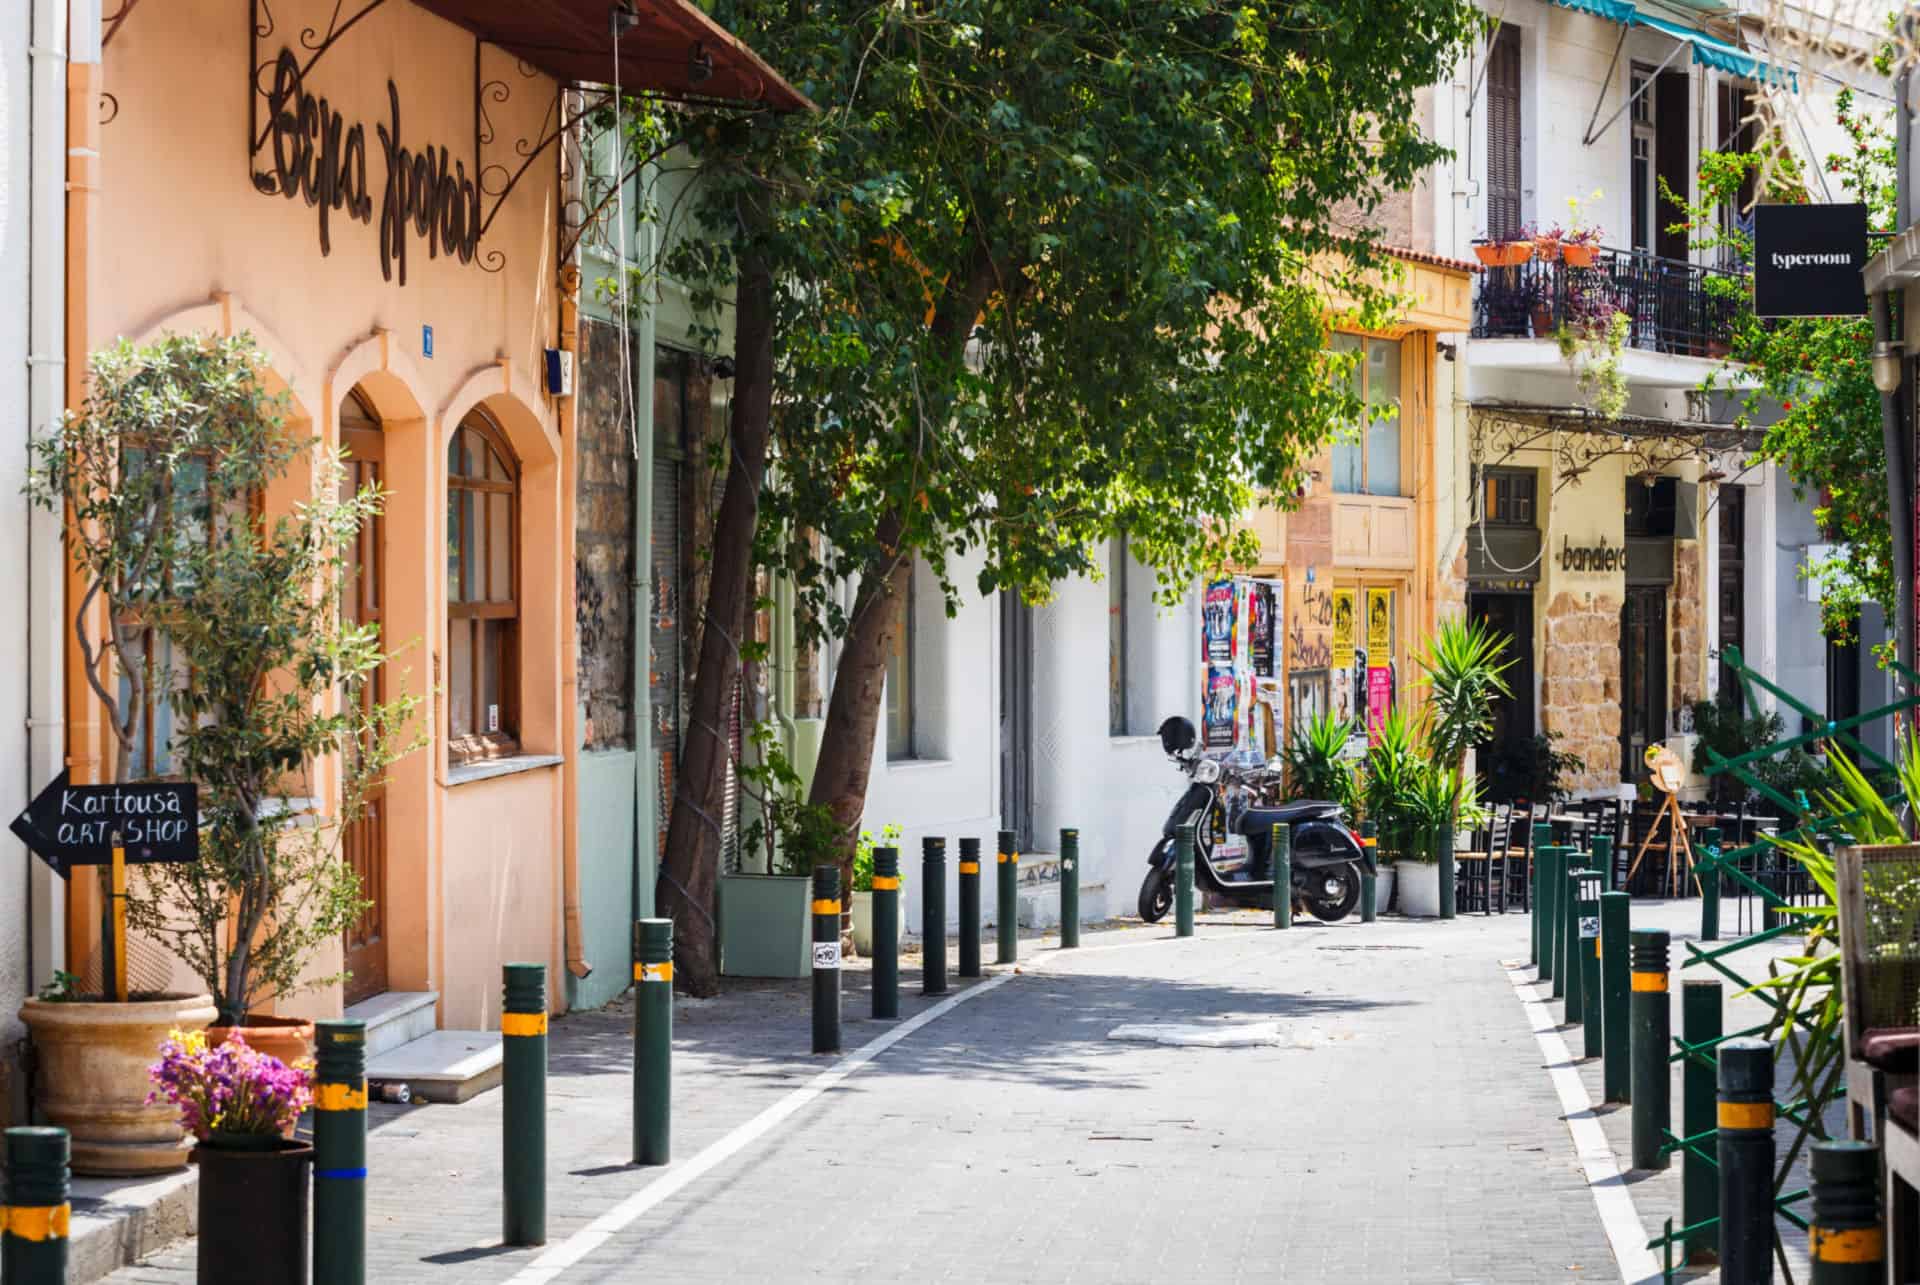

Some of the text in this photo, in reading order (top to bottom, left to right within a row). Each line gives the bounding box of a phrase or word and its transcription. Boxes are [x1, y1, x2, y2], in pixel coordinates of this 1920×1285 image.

[1771, 252, 1851, 269] typeroom
[61, 788, 182, 816] Kartousa
[127, 819, 188, 845] SHOP
